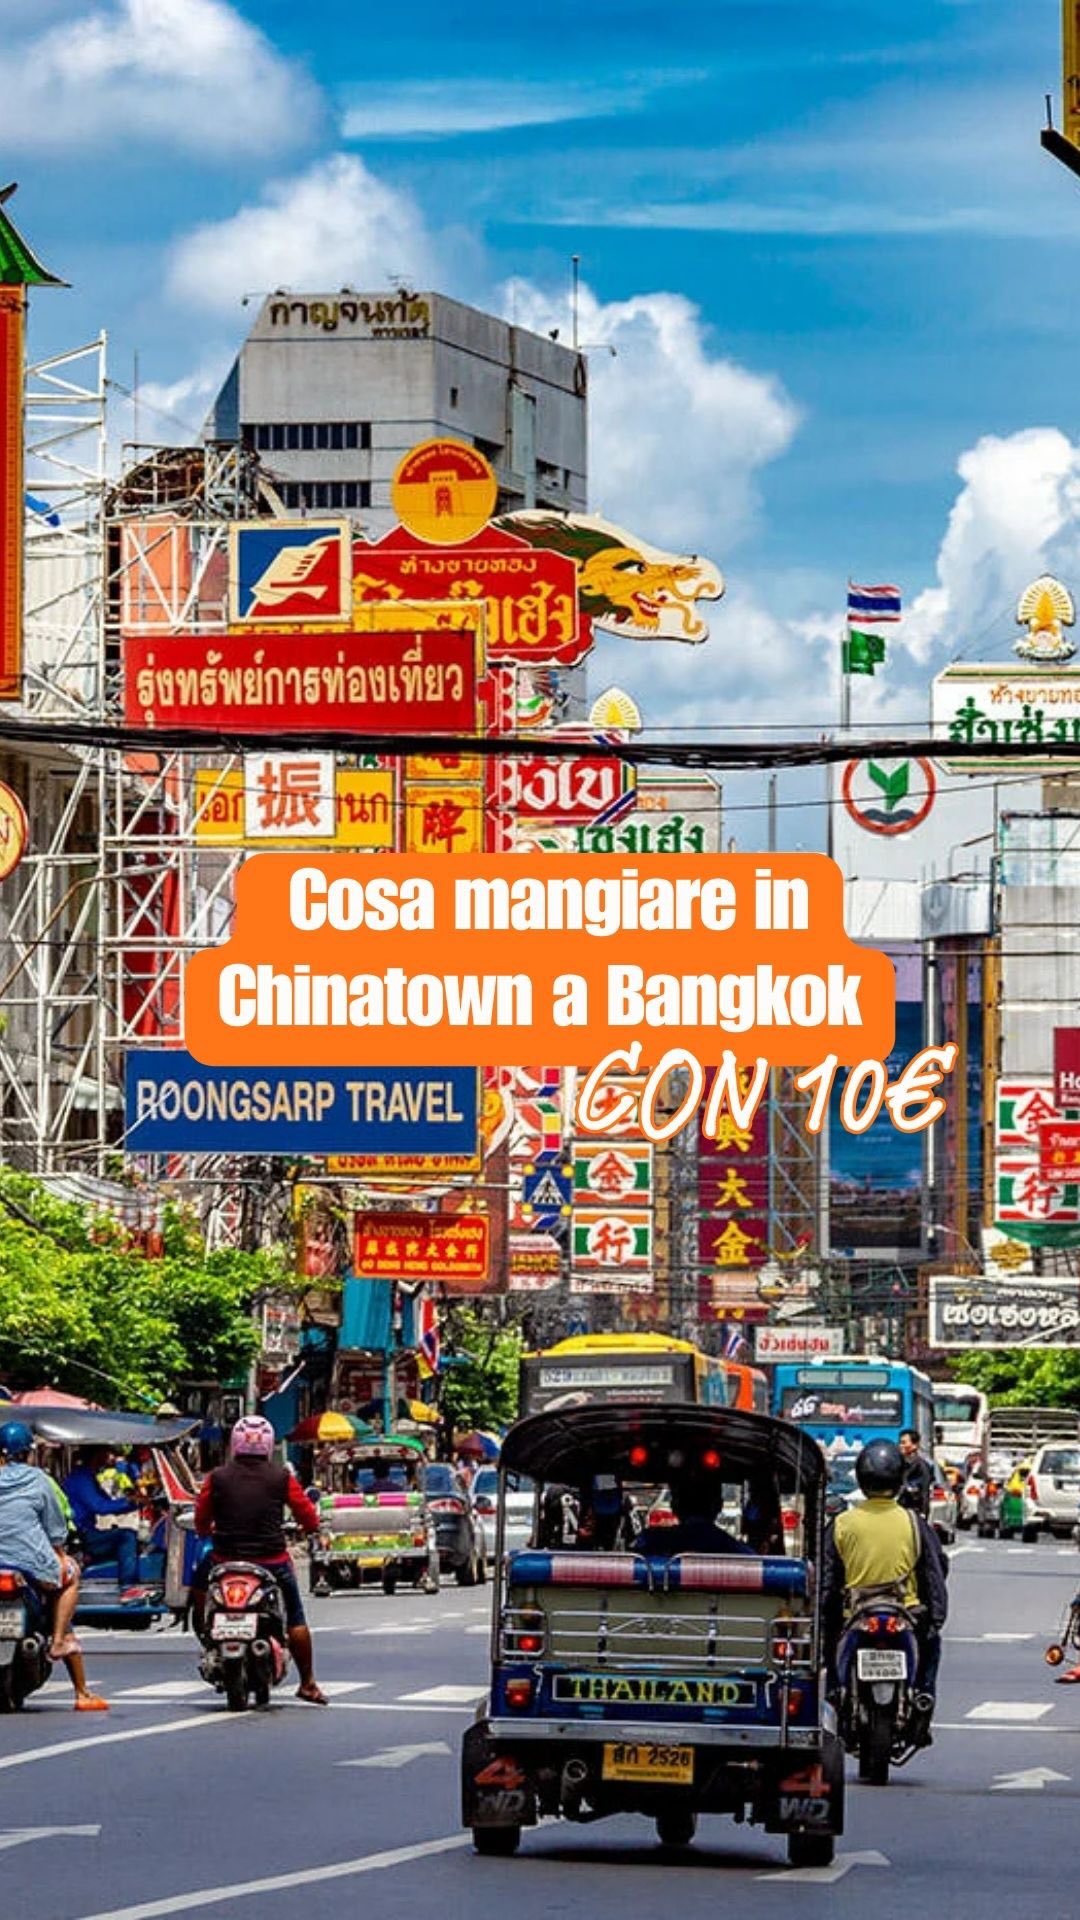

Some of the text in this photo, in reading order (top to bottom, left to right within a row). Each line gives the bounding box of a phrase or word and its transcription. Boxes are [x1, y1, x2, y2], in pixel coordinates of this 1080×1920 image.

[137, 634, 463, 729] รุ่งทรัพย์การท่องเที่ยว
[257, 761, 321, 829] 振
[136, 1080, 464, 1122] ROONGSARP TRAVEL
[570, 1676, 740, 1704] THAILAND
[474, 1757, 526, 1791] 4
[780, 1764, 832, 1797] 4
